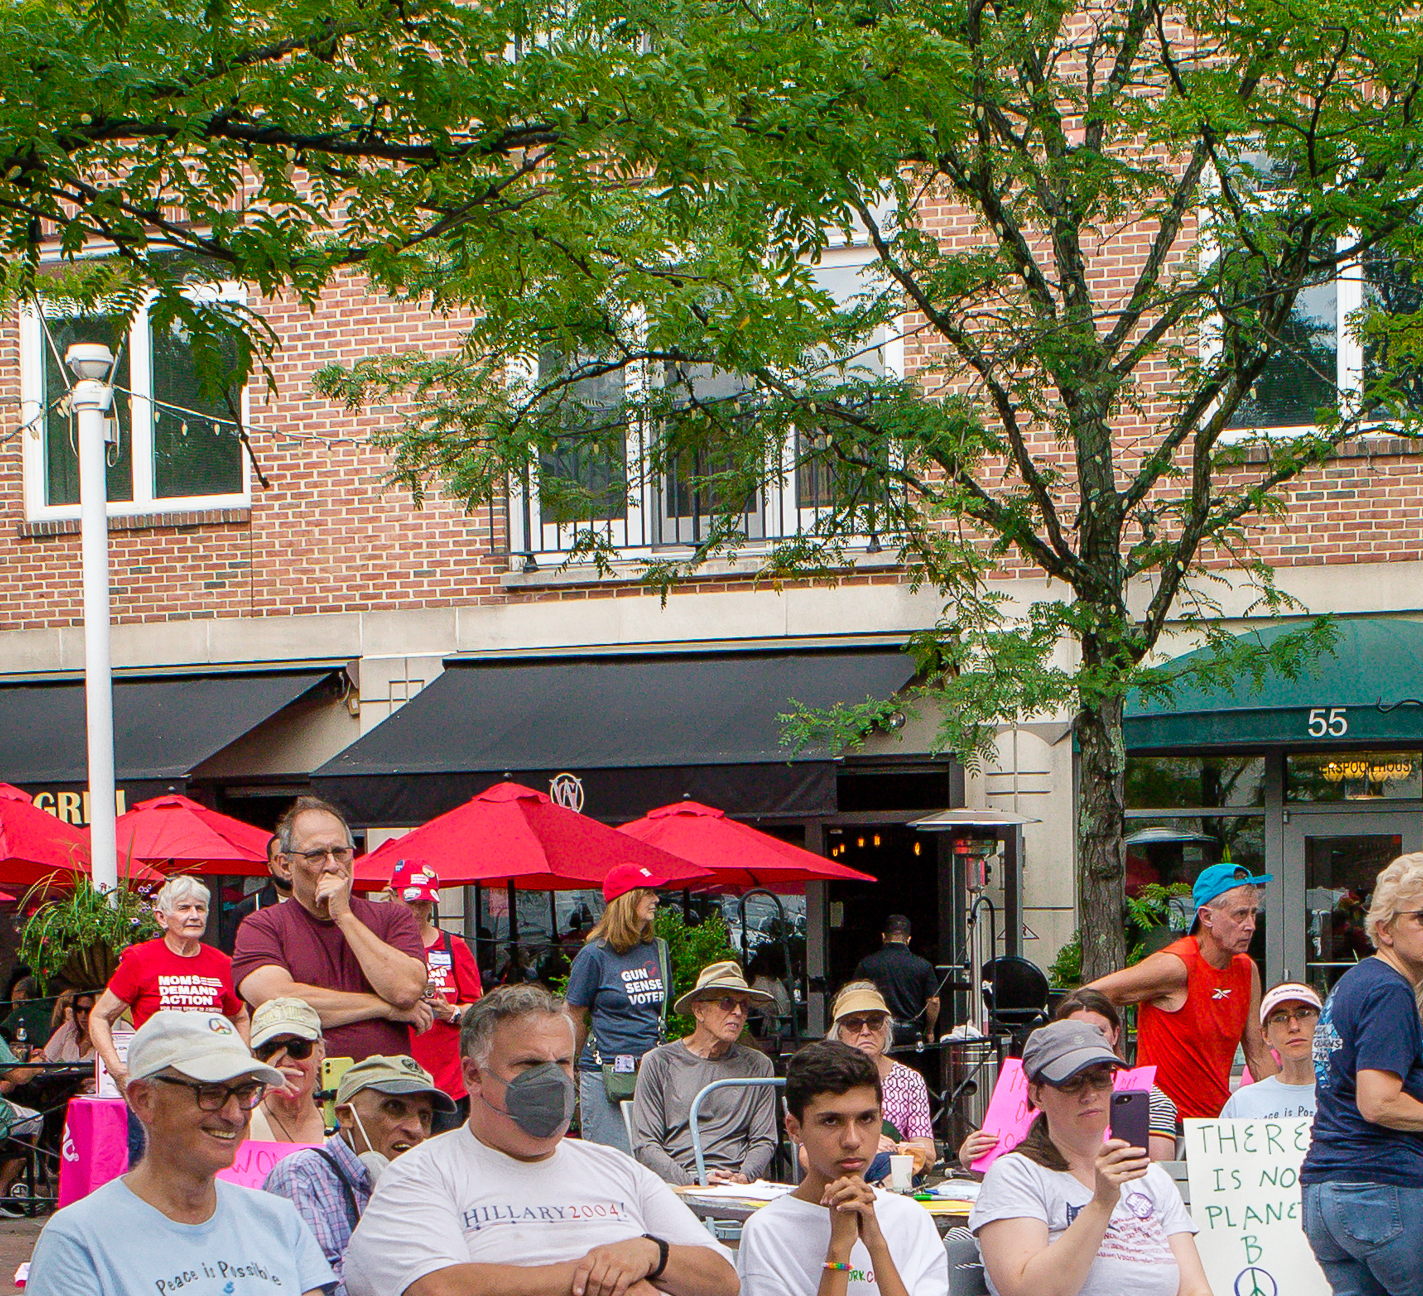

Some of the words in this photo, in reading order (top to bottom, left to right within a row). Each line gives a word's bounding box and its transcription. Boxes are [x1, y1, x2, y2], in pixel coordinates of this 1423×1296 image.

[1308, 708, 1348, 738] 55
[158, 975, 201, 986] MOMS
[621, 968, 649, 982] GUN
[159, 986, 218, 997] DEMAND
[625, 979, 663, 994] SENSE
[160, 996, 213, 1006] ACTION
[628, 991, 665, 1005] VOTER
[1284, 1107, 1293, 1117] is
[1196, 1122, 1308, 1155] THERE
[1213, 1167, 1242, 1192] IS
[1259, 1166, 1297, 1189] NO
[1204, 1201, 1302, 1231] PLANE
[1240, 1235, 1263, 1265] B
[201, 1262, 216, 1279] is
